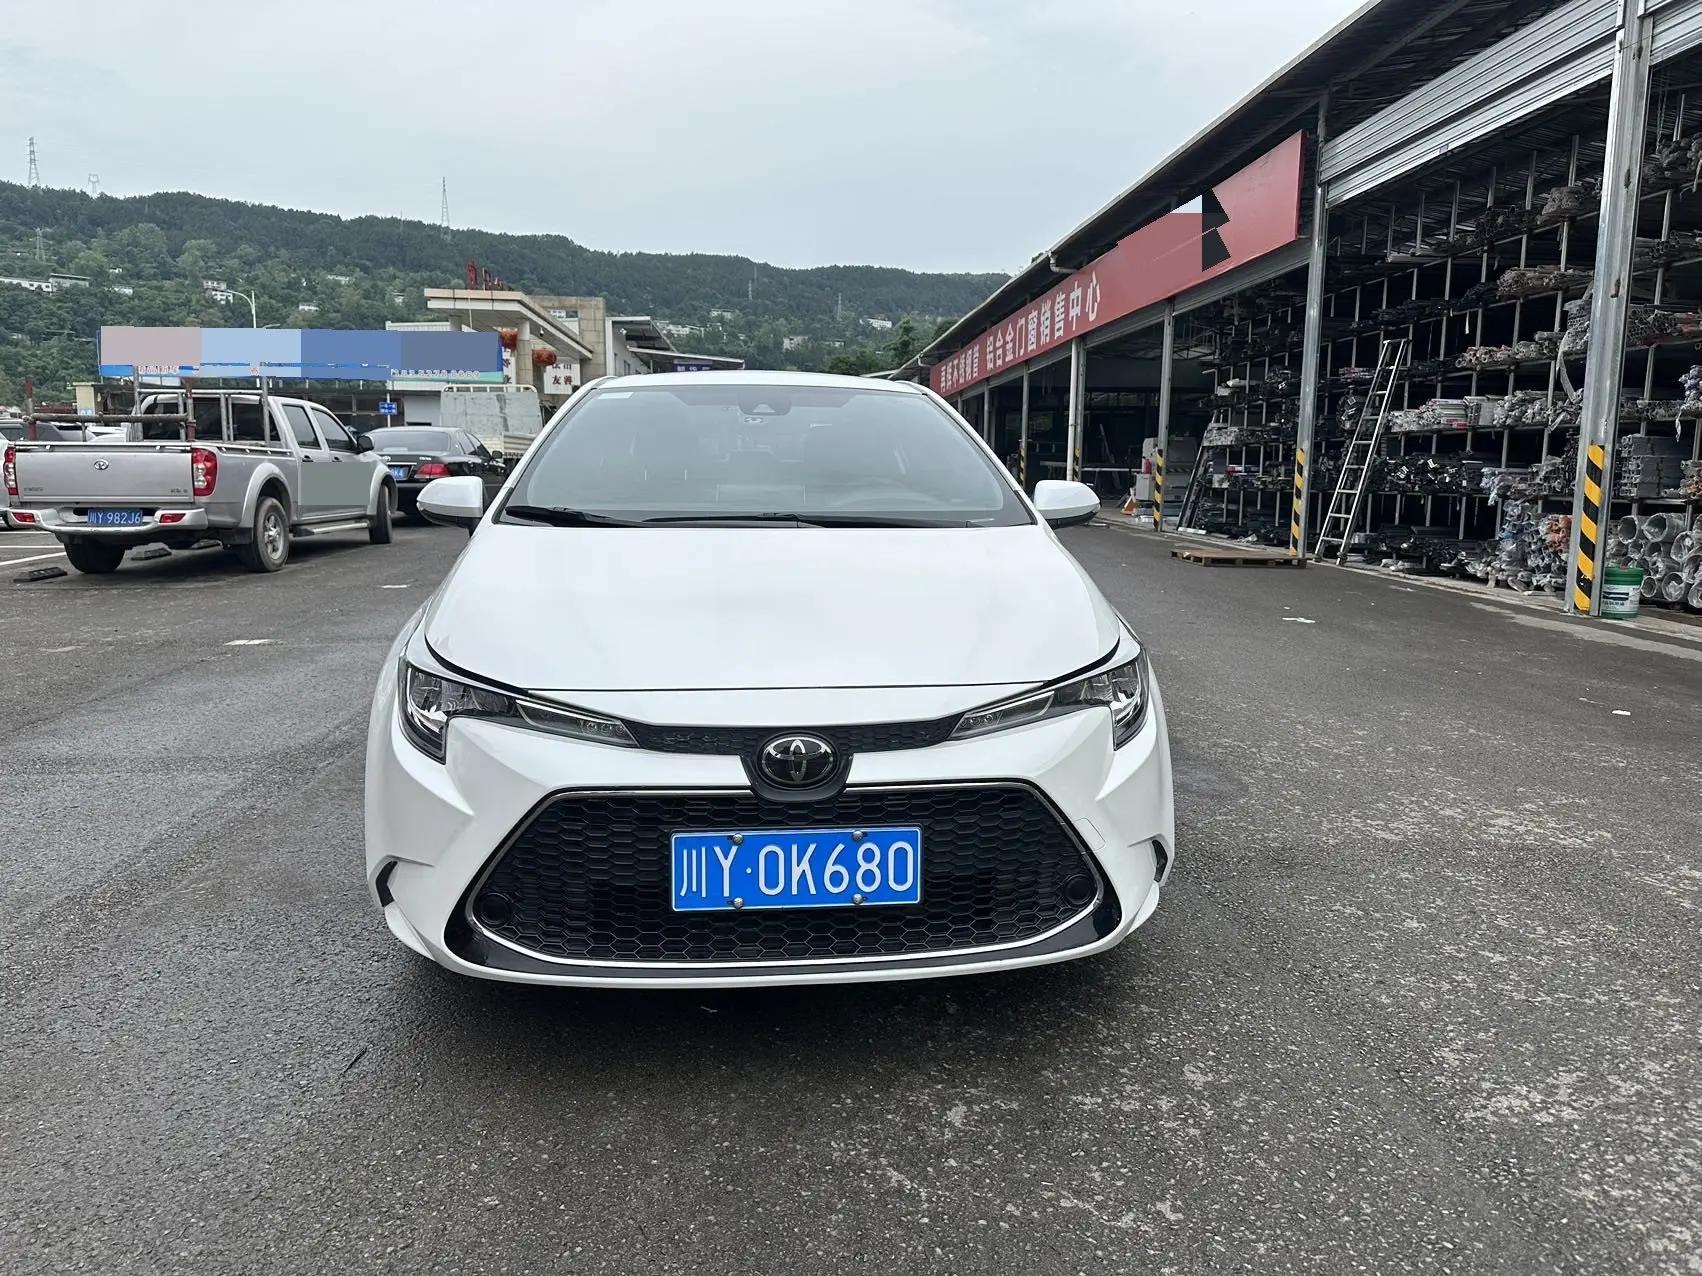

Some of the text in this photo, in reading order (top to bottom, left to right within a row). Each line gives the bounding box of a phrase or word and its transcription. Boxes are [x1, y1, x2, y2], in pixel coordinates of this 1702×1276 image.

[986, 271, 1100, 371] 铝合金门窗销售中心
